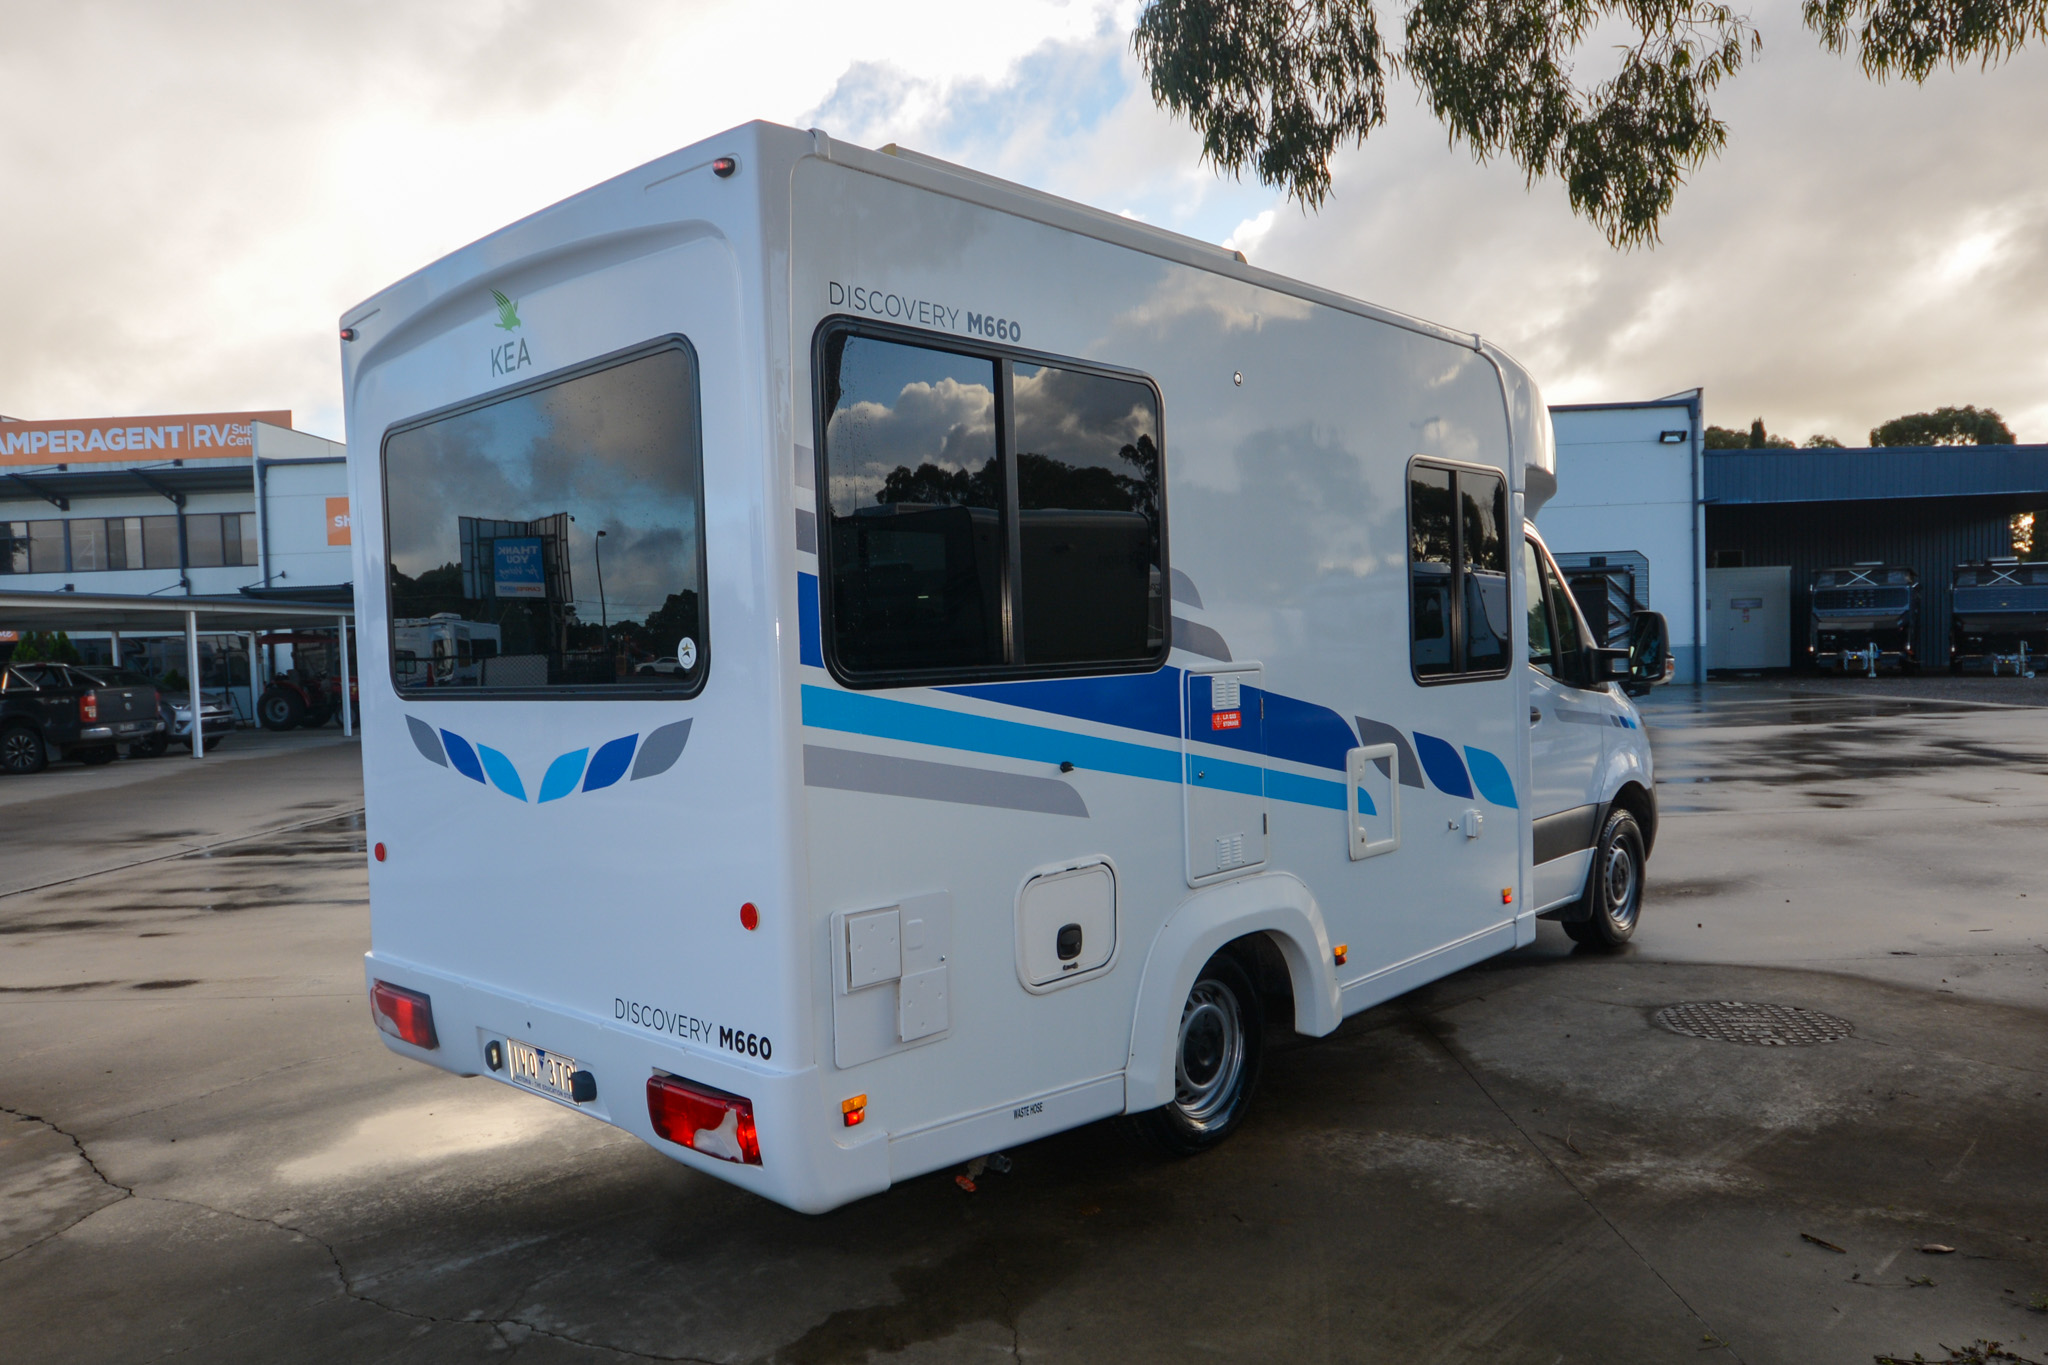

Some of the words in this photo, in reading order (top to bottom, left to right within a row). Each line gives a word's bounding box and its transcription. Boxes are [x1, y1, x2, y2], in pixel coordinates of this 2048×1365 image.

[829, 281, 959, 329] DISCOVERY
[967, 311, 1021, 342] M660
[490, 337, 532, 378] KEA
[193, 424, 230, 447] RV
[615, 998, 712, 1044] DISCOVERY
[719, 1026, 772, 1060] M660
